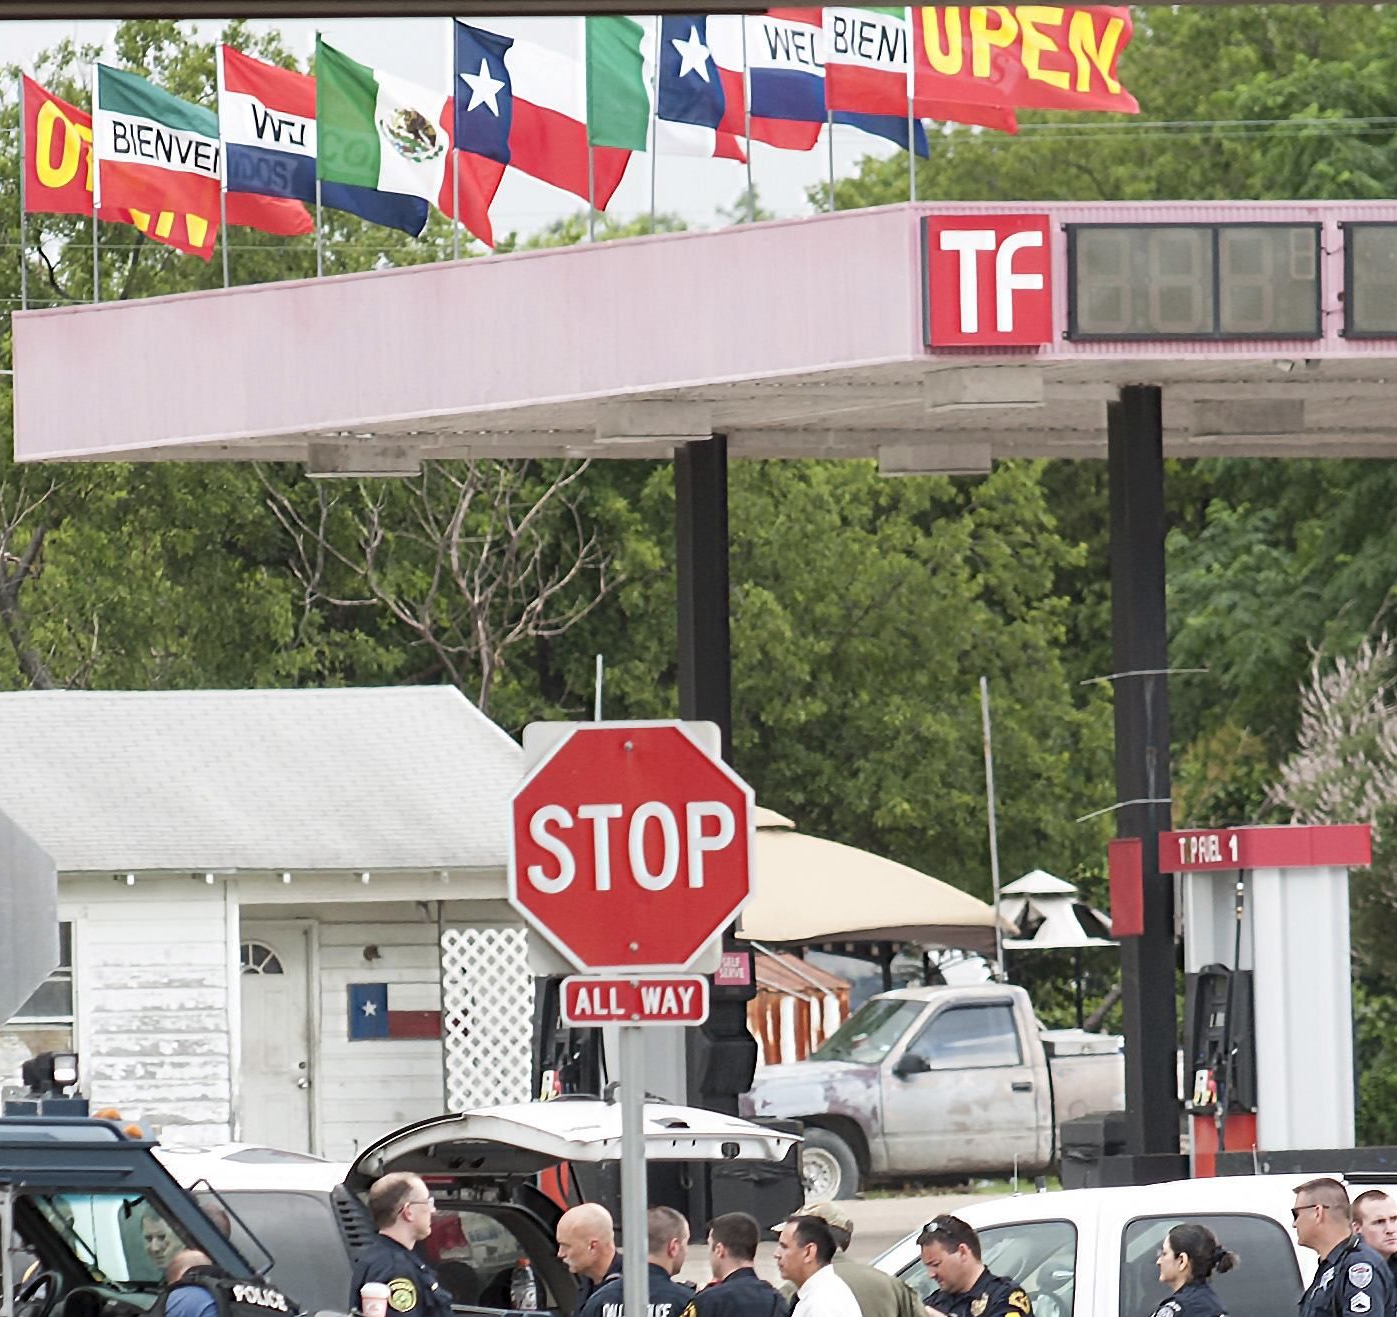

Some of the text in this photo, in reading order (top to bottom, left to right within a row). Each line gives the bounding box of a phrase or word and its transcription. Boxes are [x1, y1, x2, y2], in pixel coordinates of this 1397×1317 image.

[940, 229, 1044, 334] TF
[527, 801, 735, 894] STOP
[1229, 833, 1239, 862] 1
[574, 985, 695, 1016] ALL WAY
[233, 1284, 289, 1312] POLICE
